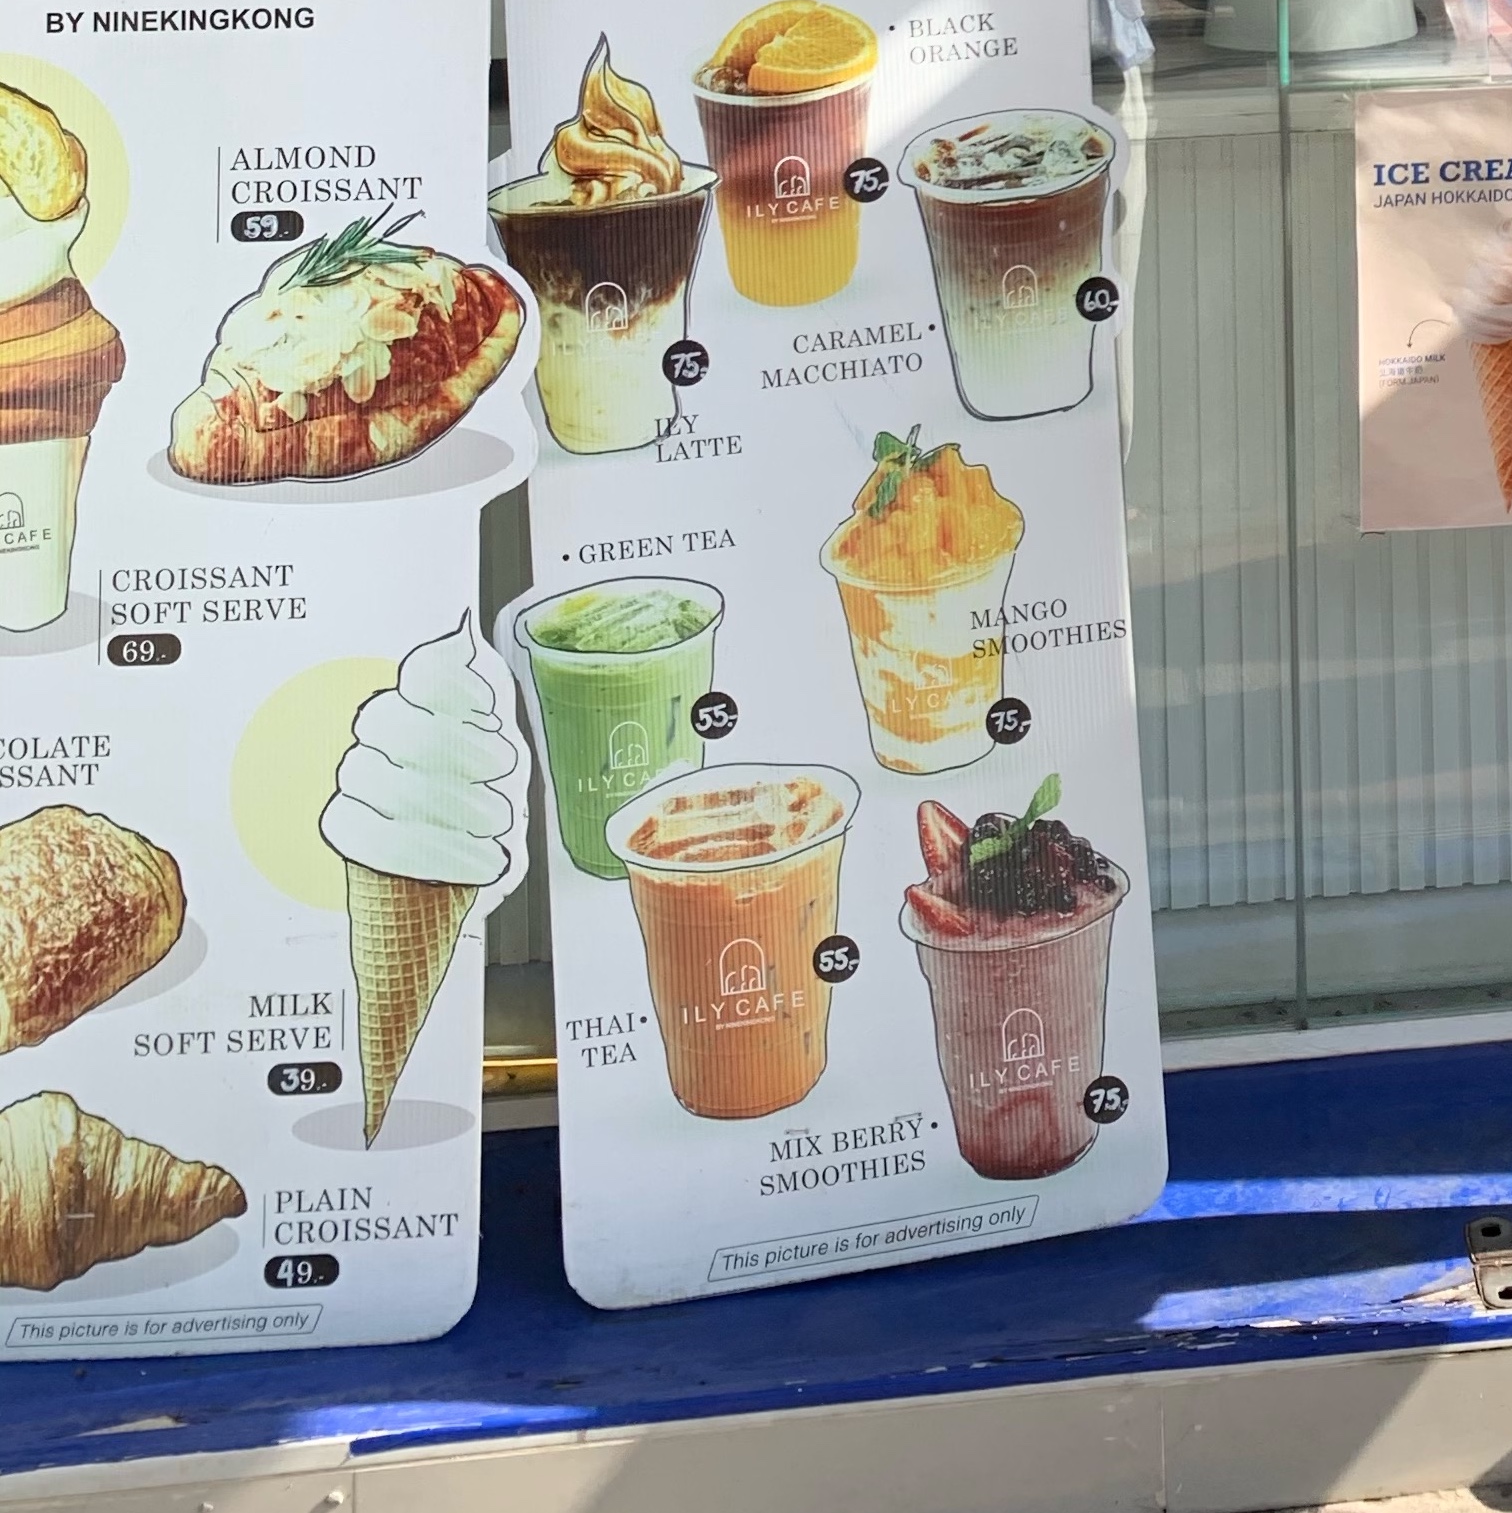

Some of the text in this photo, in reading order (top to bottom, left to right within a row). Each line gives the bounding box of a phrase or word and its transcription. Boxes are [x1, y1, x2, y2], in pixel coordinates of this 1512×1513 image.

[46, 7, 316, 34] BY NINEKINGKONG
[909, 12, 996, 40] BLACK
[910, 37, 1019, 66] ORANGE
[229, 145, 378, 172] ALMOND
[1374, 163, 1430, 186] ICE
[230, 177, 423, 204] CROISSANT
[1374, 191, 1427, 208] JAPAN
[747, 196, 840, 218] ILY CAFE
[792, 323, 924, 355] CARAMEL
[761, 353, 924, 391] MACCHIATO
[654, 414, 700, 438] ILY
[655, 435, 743, 463] LATTE
[4, 528, 52, 545] CAFE
[578, 527, 737, 566] GREEN TEA
[111, 565, 295, 591] CROISSANT
[110, 597, 308, 627] SOFT SERVE
[969, 597, 1069, 631] MANGO
[972, 619, 1127, 660] SMOOTHIES
[0, 735, 111, 760] OLATE
[0, 763, 100, 789] SSANT
[578, 774, 614, 792] ILY
[249, 992, 332, 1020] MILK
[683, 1002, 725, 1024] ILY
[736, 990, 805, 1016] CAFE
[133, 1026, 332, 1057] SOFT SERVE
[566, 1013, 637, 1042] THAI
[581, 1043, 637, 1069] TEA
[969, 1068, 1008, 1089] ILY
[1017, 1056, 1081, 1081] CAFE
[769, 1118, 924, 1164] MIX BERRY
[760, 1149, 927, 1197] SMOOTHIES
[274, 1187, 374, 1214] PLAIN
[273, 1213, 461, 1245] CROISSANT
[722, 1204, 1027, 1272] This picture is for advertising only
[19, 1311, 311, 1345] This picture is for advertising only
